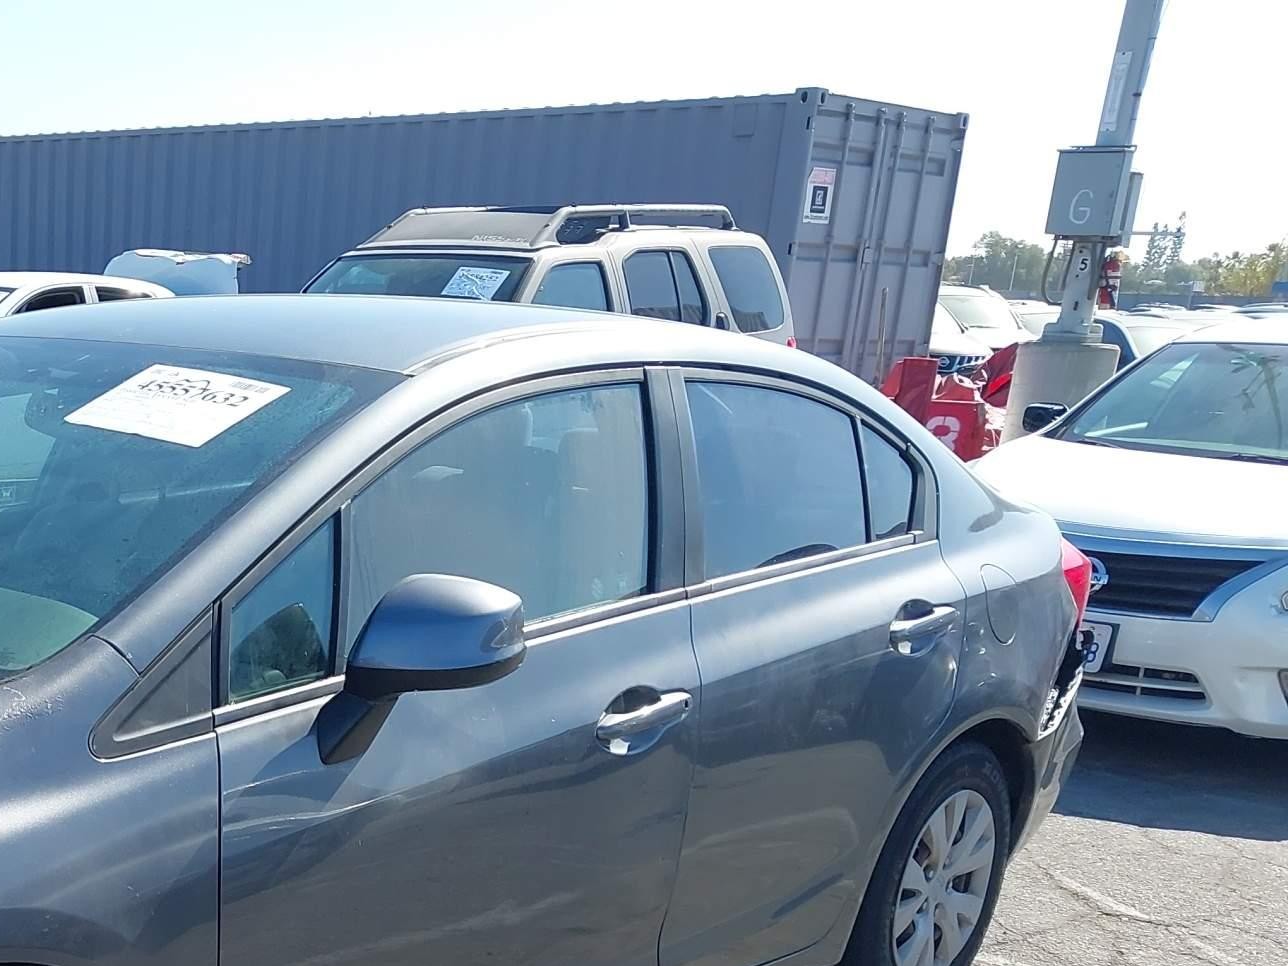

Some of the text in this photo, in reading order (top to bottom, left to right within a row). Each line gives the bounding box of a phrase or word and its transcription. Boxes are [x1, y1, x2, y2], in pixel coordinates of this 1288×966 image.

[1068, 189, 1094, 225] G
[1079, 258, 1089, 271] 5
[137, 380, 249, 407] 45557632
